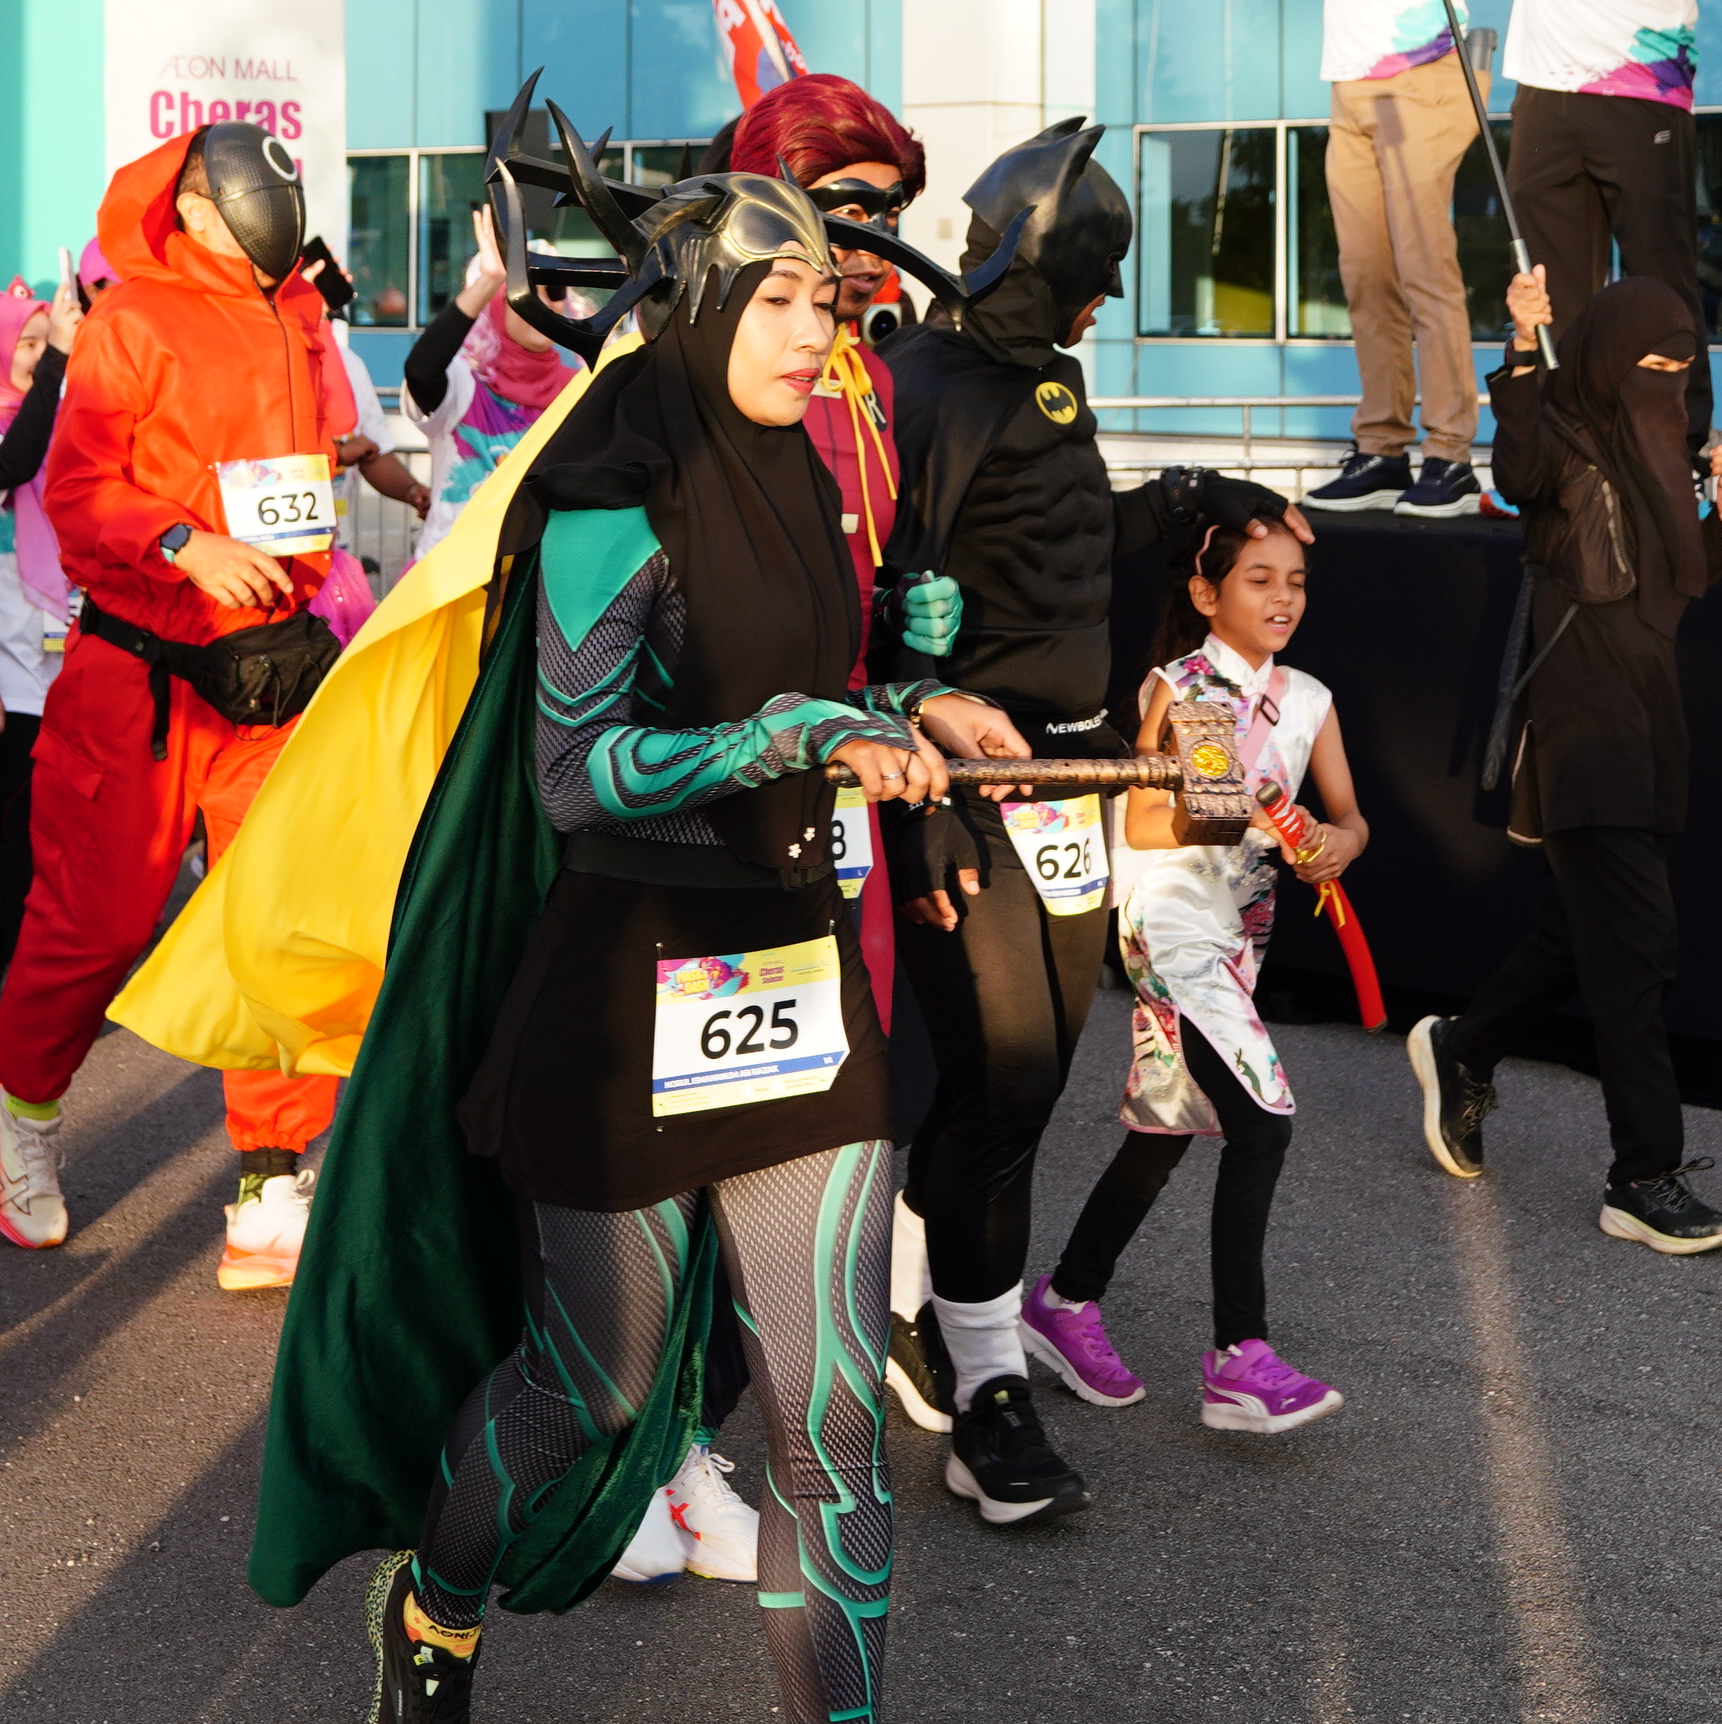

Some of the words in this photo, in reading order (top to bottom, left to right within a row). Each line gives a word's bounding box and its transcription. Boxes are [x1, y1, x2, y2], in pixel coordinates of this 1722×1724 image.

[233, 58, 299, 83] MALL
[864, 389, 887, 424] R
[257, 491, 320, 526] 632
[1036, 837, 1092, 881] 626
[700, 998, 799, 1060] 625
